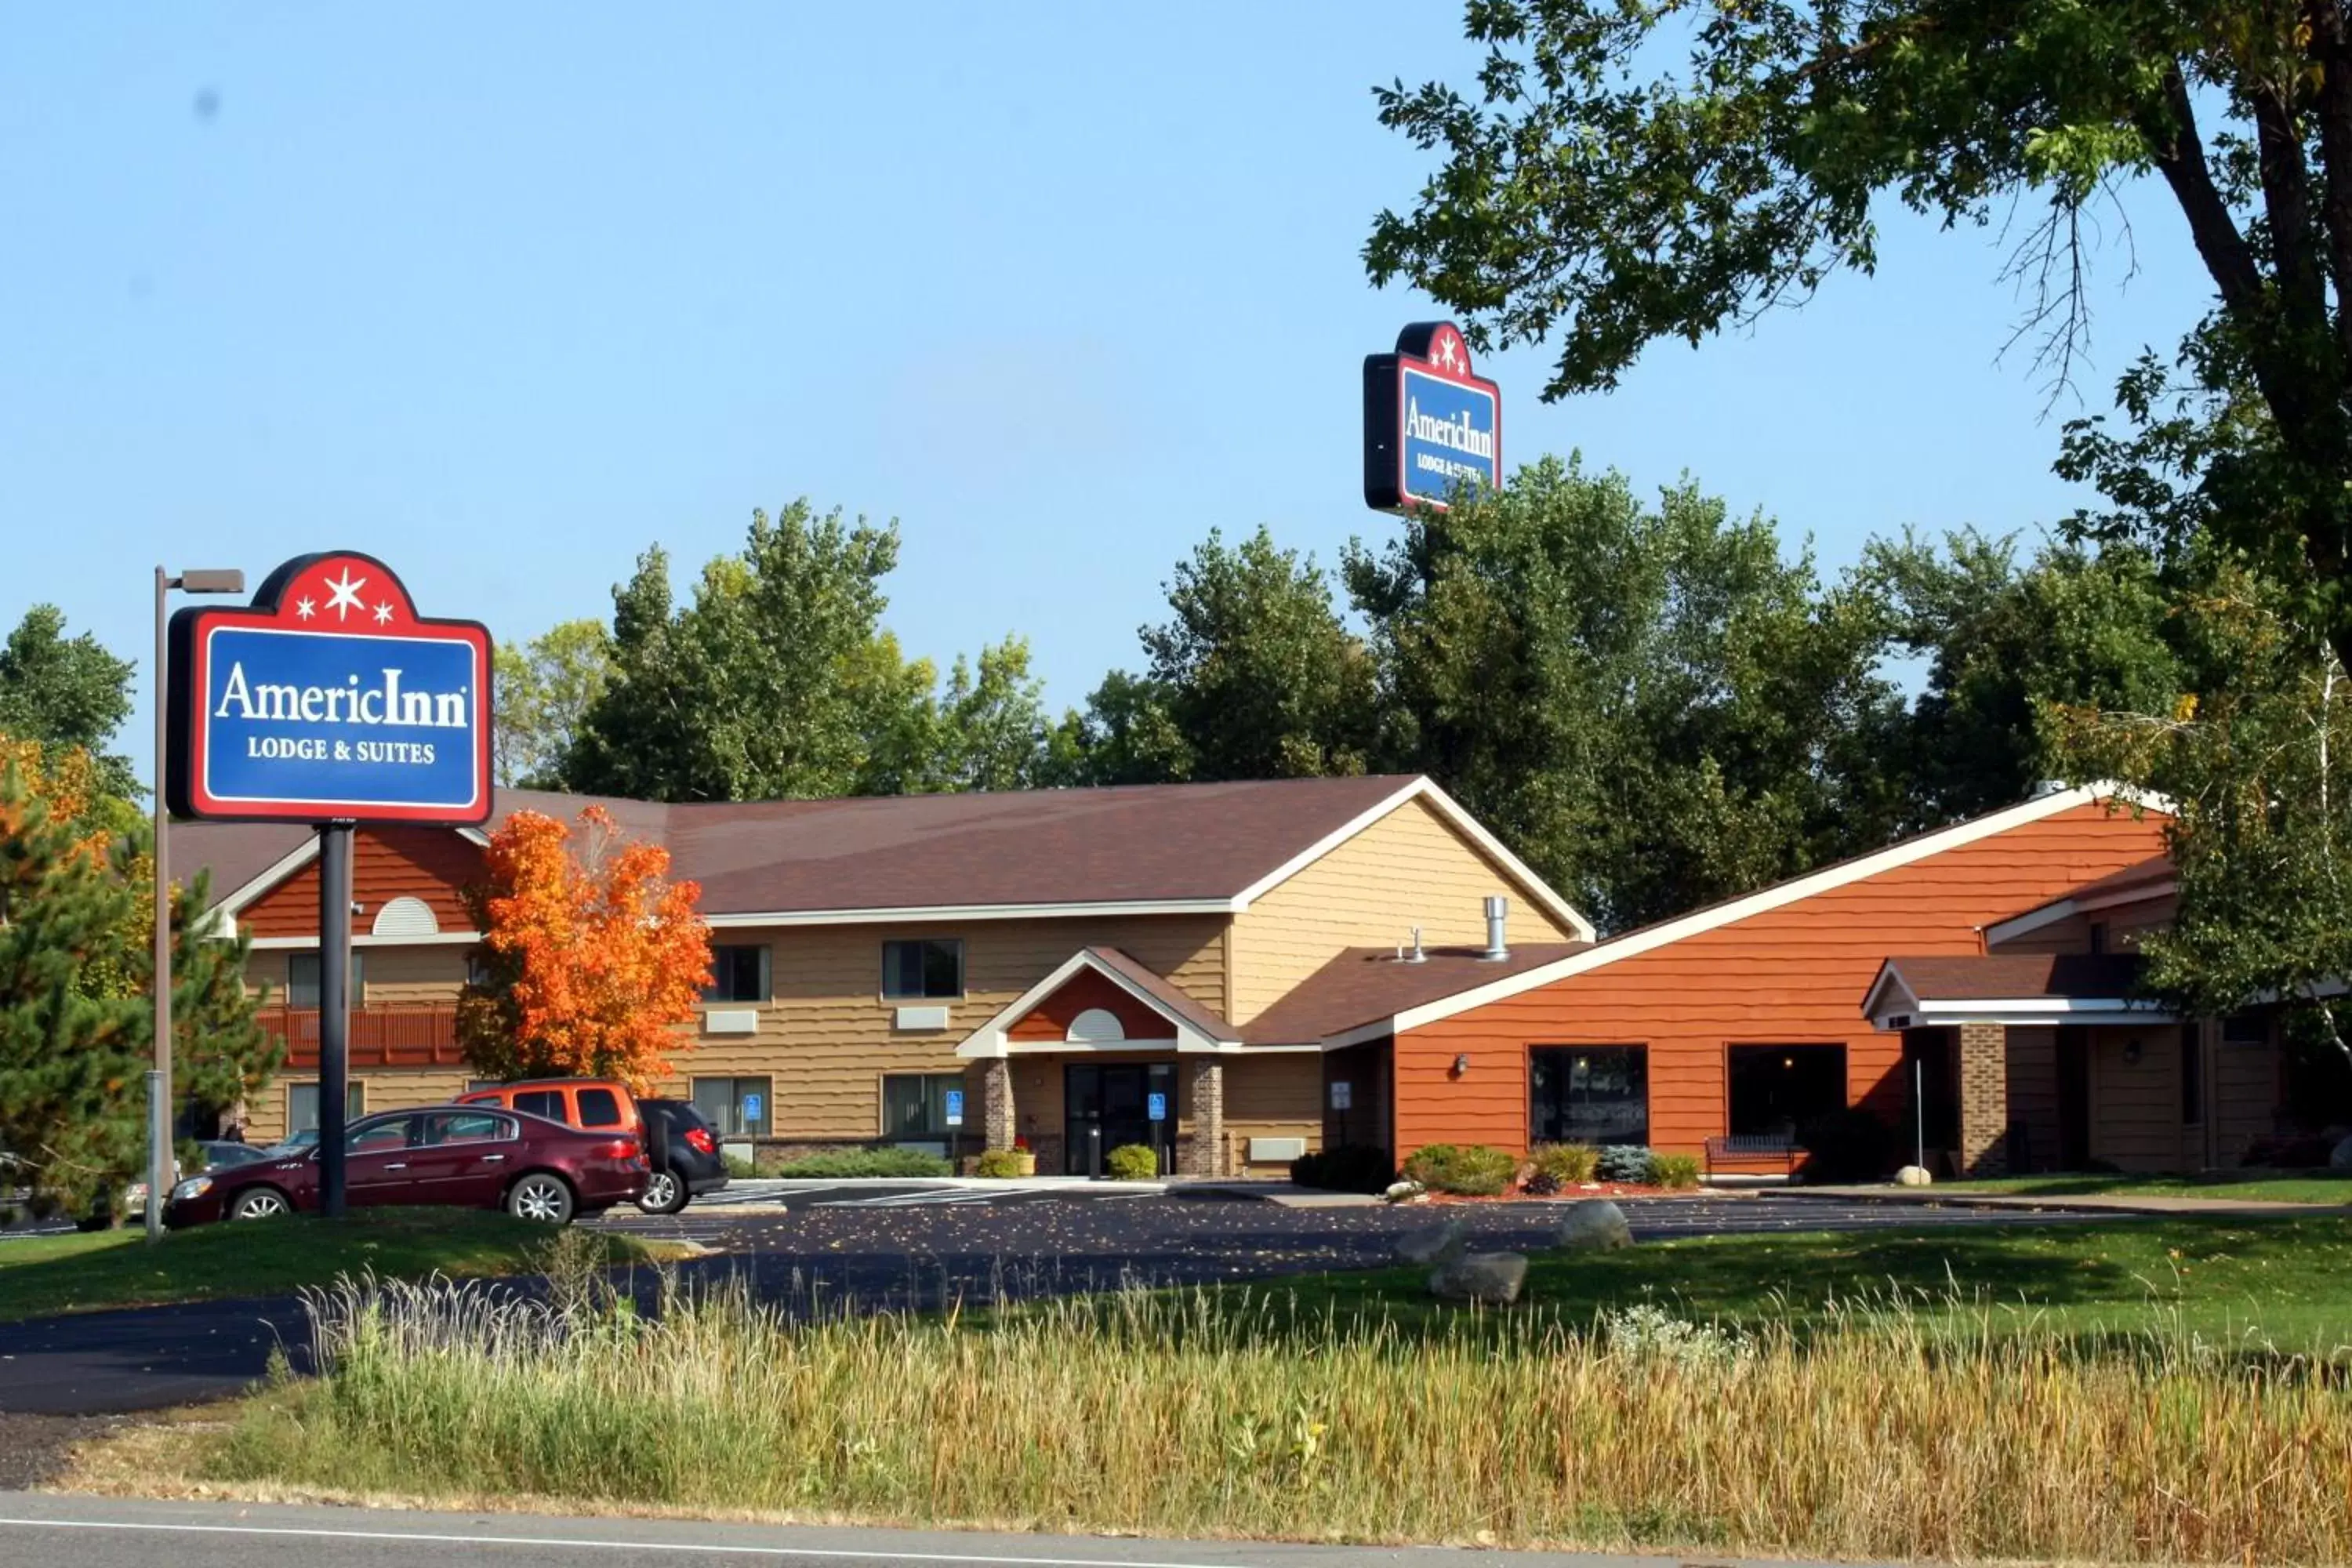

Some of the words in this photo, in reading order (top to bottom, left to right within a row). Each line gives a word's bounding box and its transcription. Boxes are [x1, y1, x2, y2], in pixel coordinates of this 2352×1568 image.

[1406, 396, 1493, 458] AmericInn
[1417, 452, 1445, 474] LODGE
[215, 661, 467, 728] AmericInn
[248, 737, 328, 760] LODGE
[333, 740, 351, 760] &
[357, 742, 435, 764] SUITES
